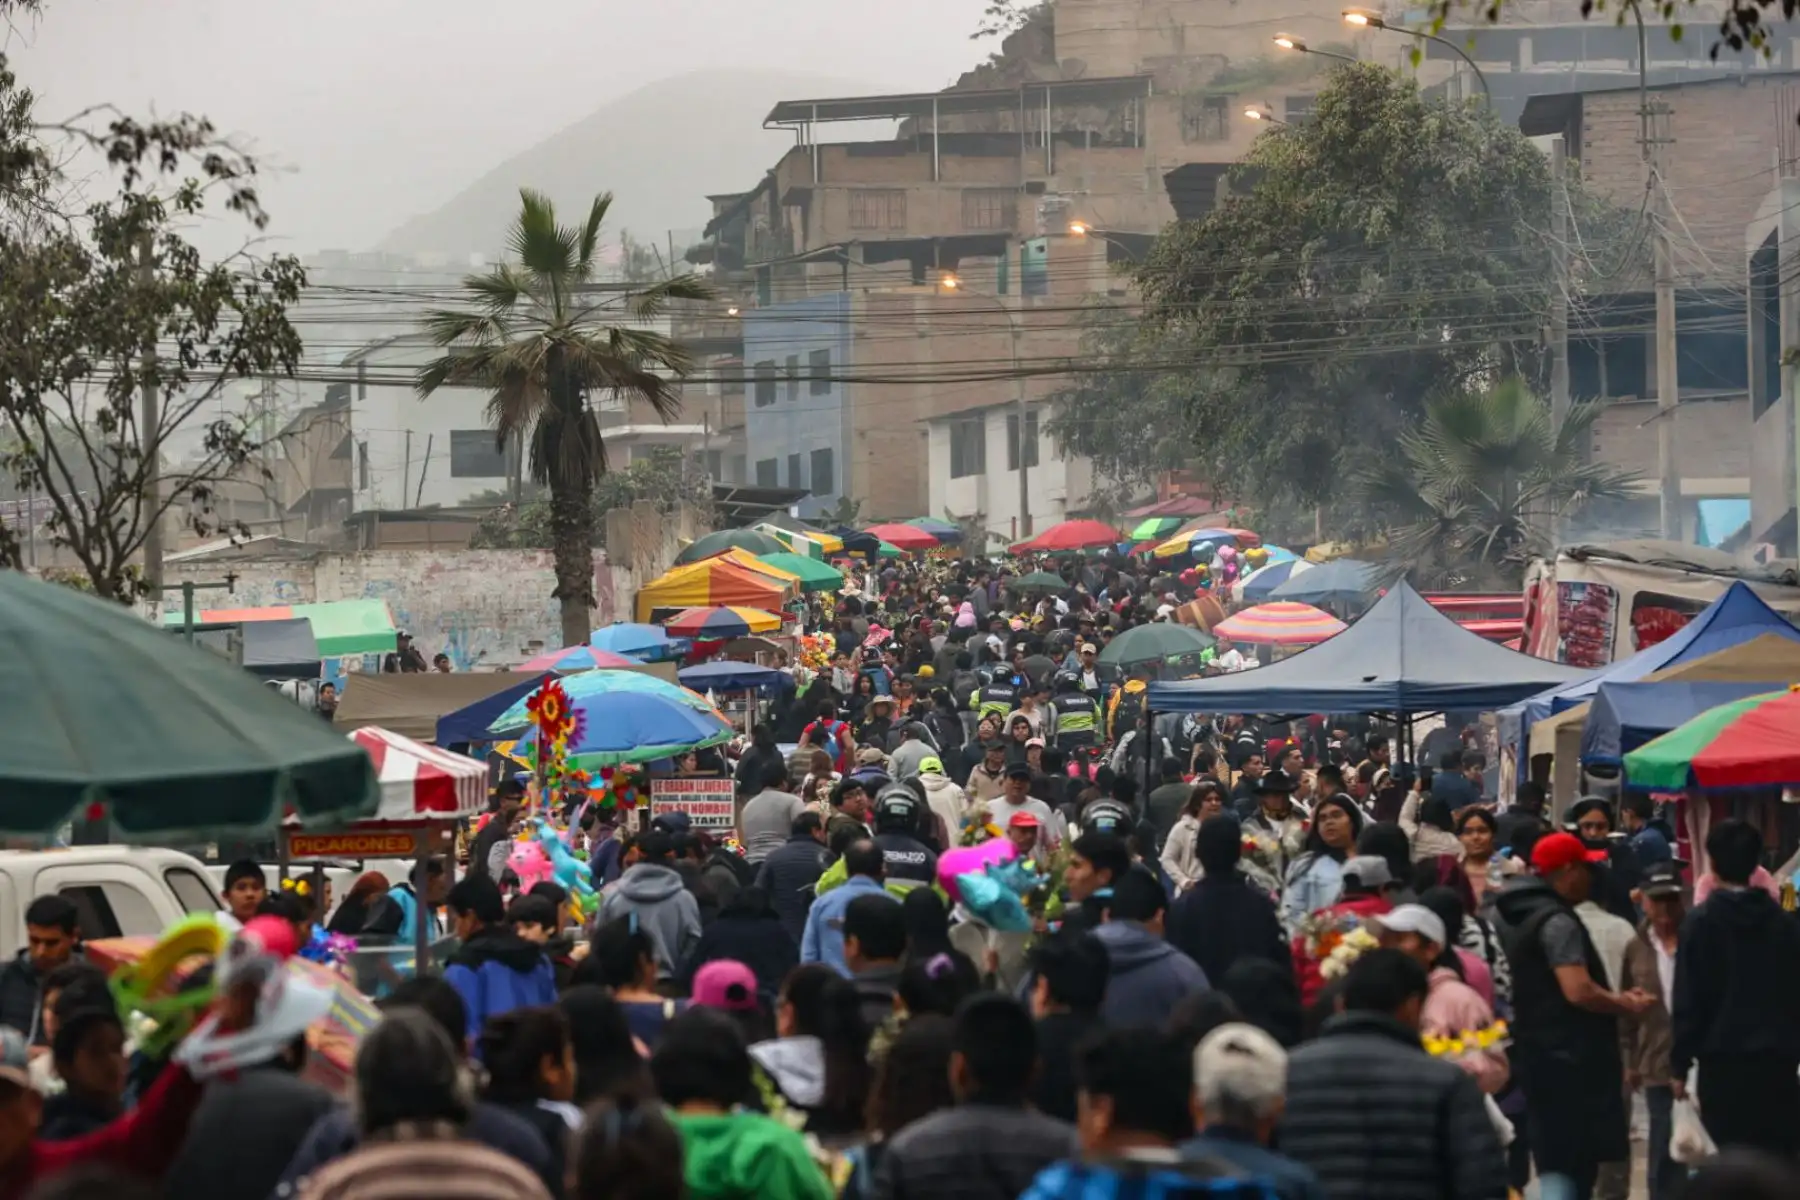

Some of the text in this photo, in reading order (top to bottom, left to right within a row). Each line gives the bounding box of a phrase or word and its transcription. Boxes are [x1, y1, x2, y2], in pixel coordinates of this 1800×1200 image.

[696, 780, 732, 793] LLAVEROS
[690, 803, 732, 814] NOMBRE
[294, 836, 411, 853] PICARONES
